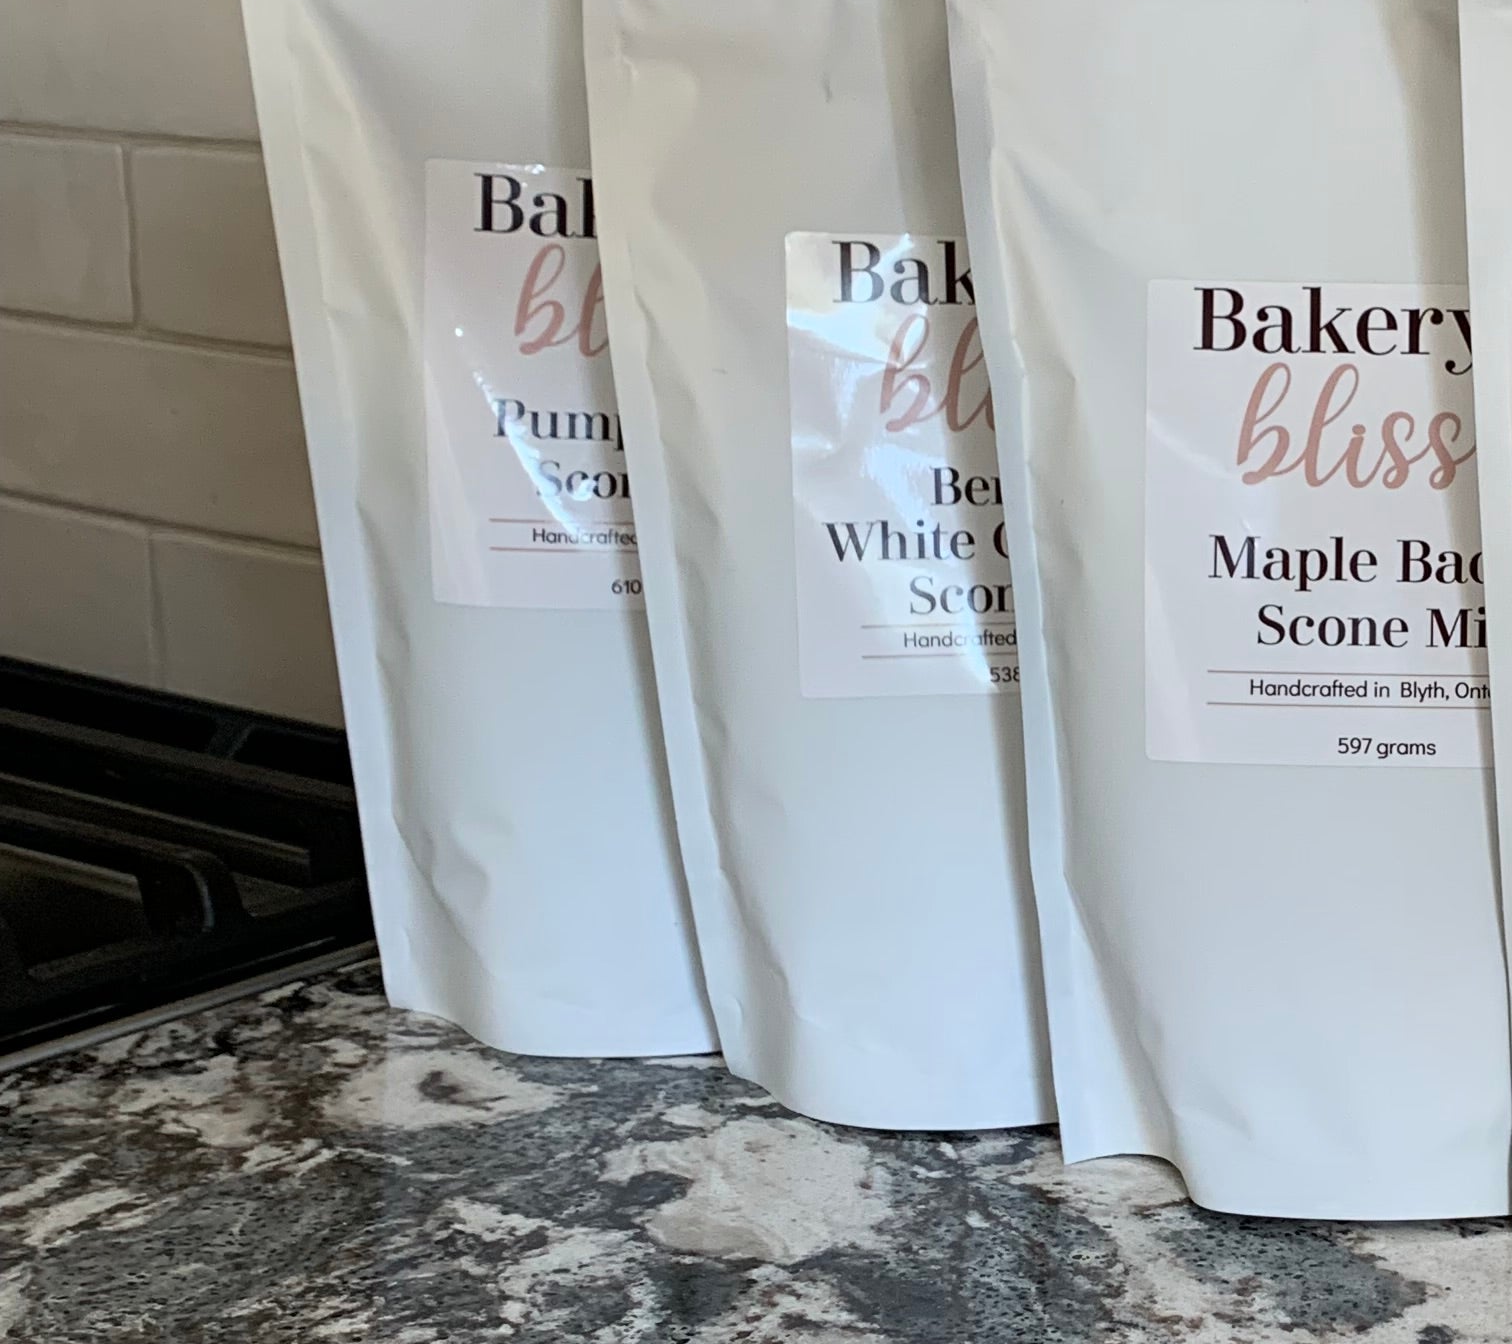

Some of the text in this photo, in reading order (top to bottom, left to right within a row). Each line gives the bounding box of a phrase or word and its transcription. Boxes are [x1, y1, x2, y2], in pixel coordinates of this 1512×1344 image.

[832, 240, 975, 305] Bak
[880, 313, 995, 432] bl
[493, 399, 624, 451] Pum
[1237, 362, 1477, 490] bliss
[822, 519, 975, 562] White
[1208, 535, 1378, 592] Maple
[612, 578, 641, 594] 610
[1257, 604, 1408, 647] Scone
[1250, 679, 1368, 698] Handcrafted
[1374, 681, 1390, 698] in
[1400, 682, 1450, 701] Blyth,
[1337, 738, 1437, 759] 597 grams
